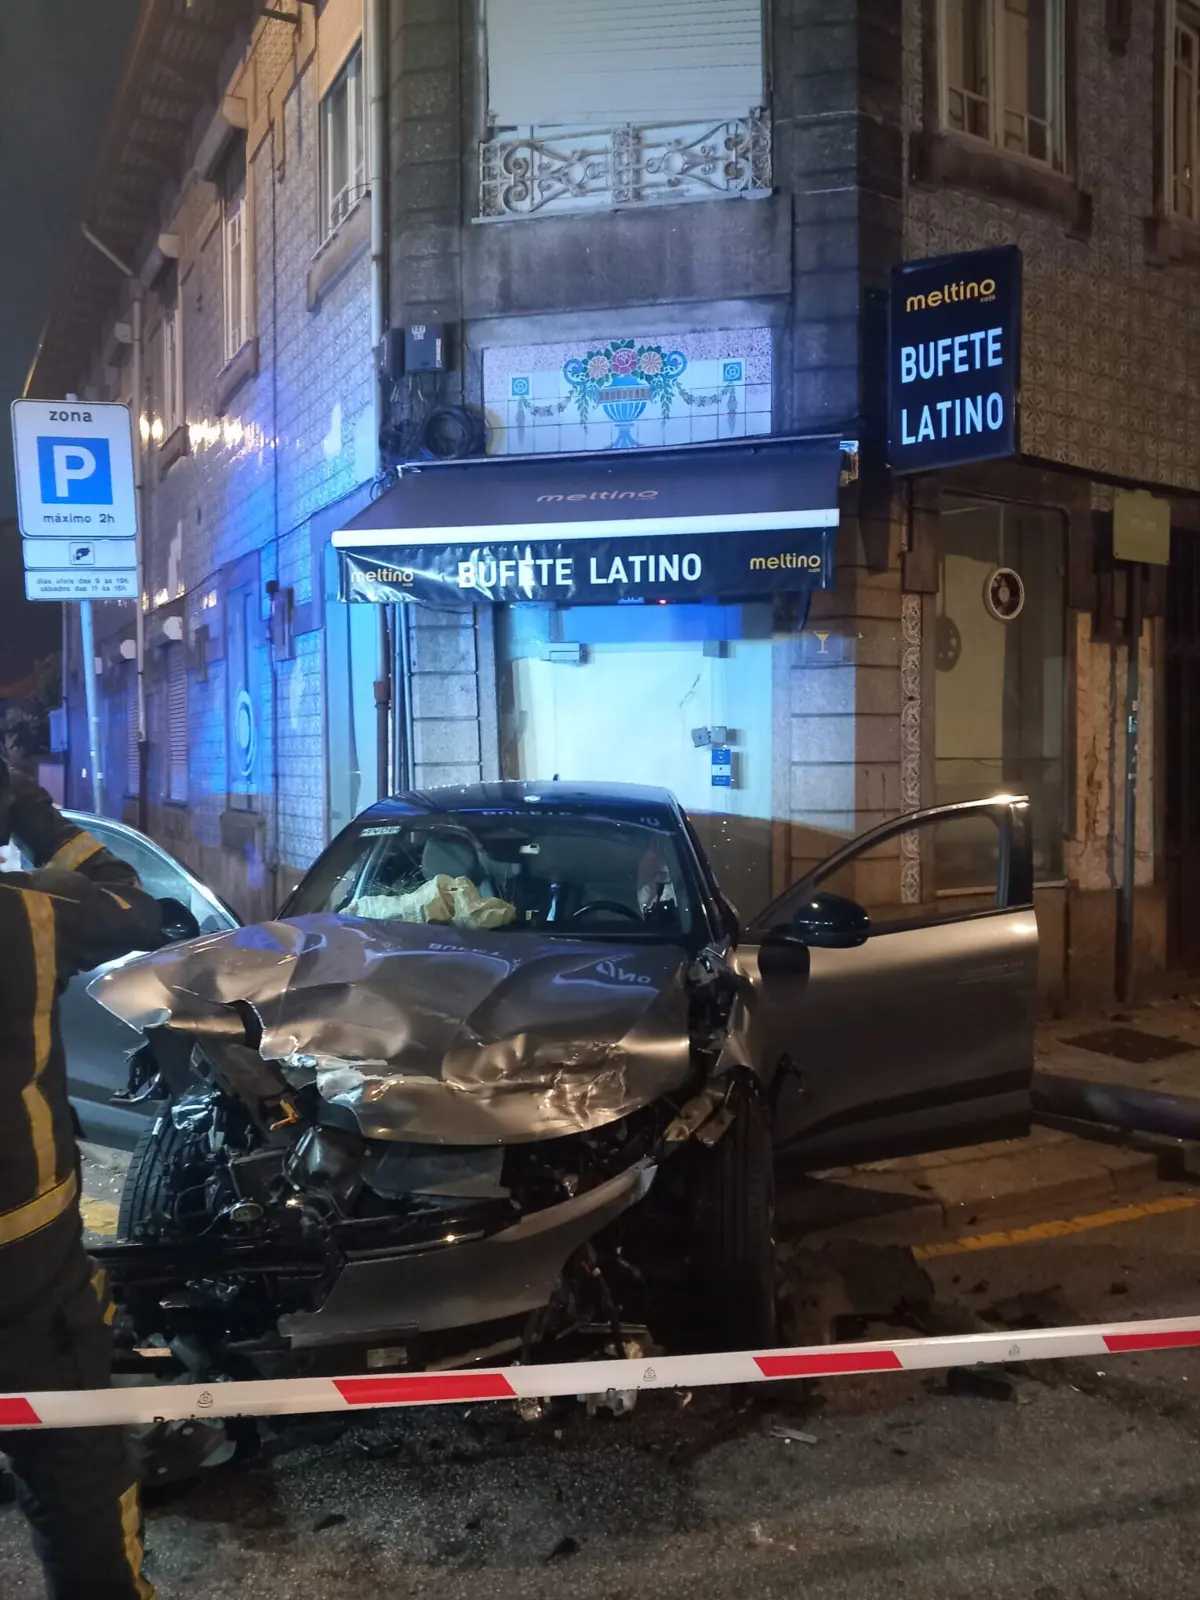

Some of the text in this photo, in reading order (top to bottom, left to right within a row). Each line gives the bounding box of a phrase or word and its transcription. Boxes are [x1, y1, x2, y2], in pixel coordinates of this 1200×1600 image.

[906, 278, 996, 313] meltino
[901, 327, 1003, 384] BUFETE
[49, 410, 93, 423] zona
[901, 392, 1004, 446] LATINO
[53, 445, 97, 498] P
[536, 490, 659, 502] meltino
[43, 512, 115, 523] máximo 2h
[458, 553, 702, 588] BUFETE LATINO
[750, 553, 821, 570] meltino
[351, 568, 414, 583] meltino
